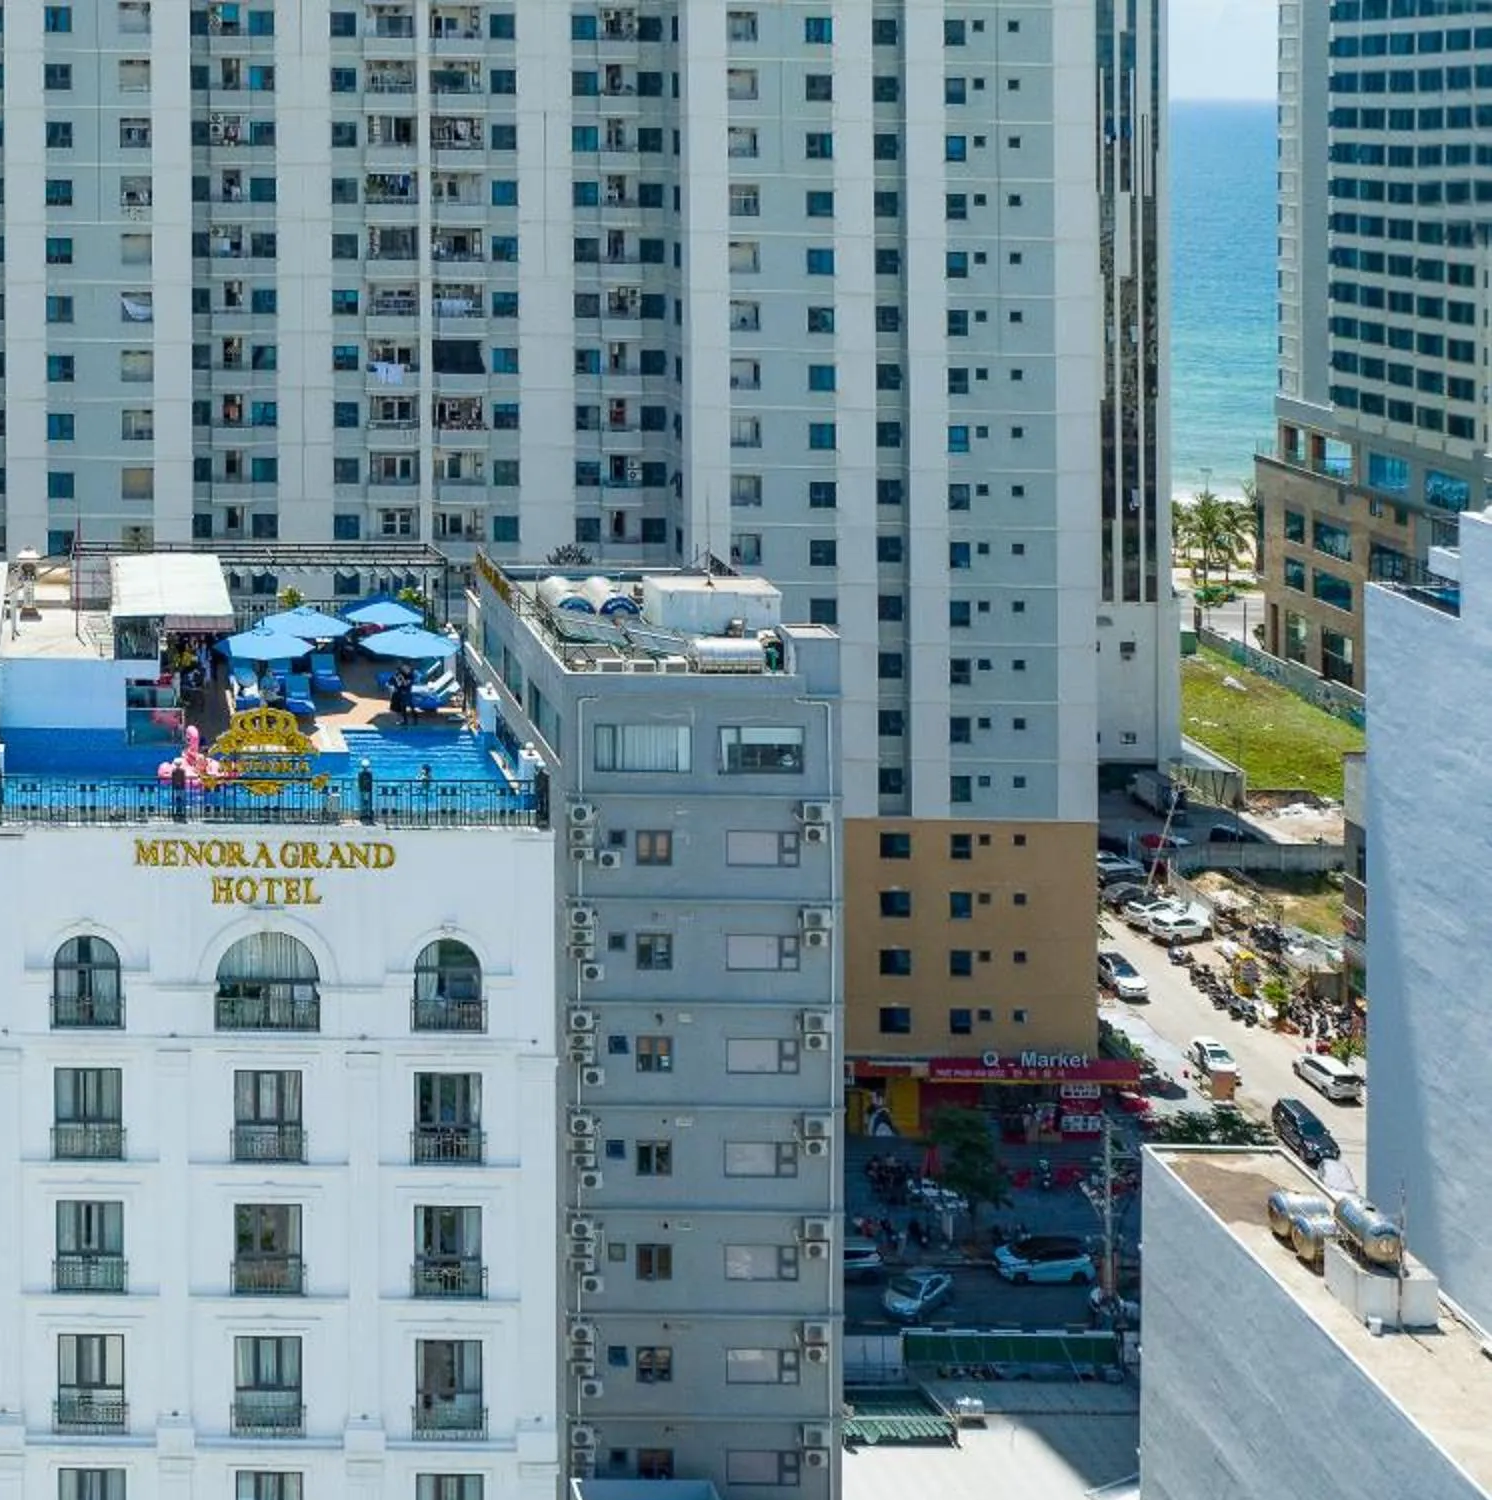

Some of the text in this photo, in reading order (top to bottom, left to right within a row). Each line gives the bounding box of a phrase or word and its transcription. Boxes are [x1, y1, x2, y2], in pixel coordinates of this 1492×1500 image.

[134, 839, 397, 869] MENORA GRAND
[211, 876, 323, 905] HOTEL
[982, 1051, 999, 1067] Q
[1021, 1051, 1089, 1068] Market
